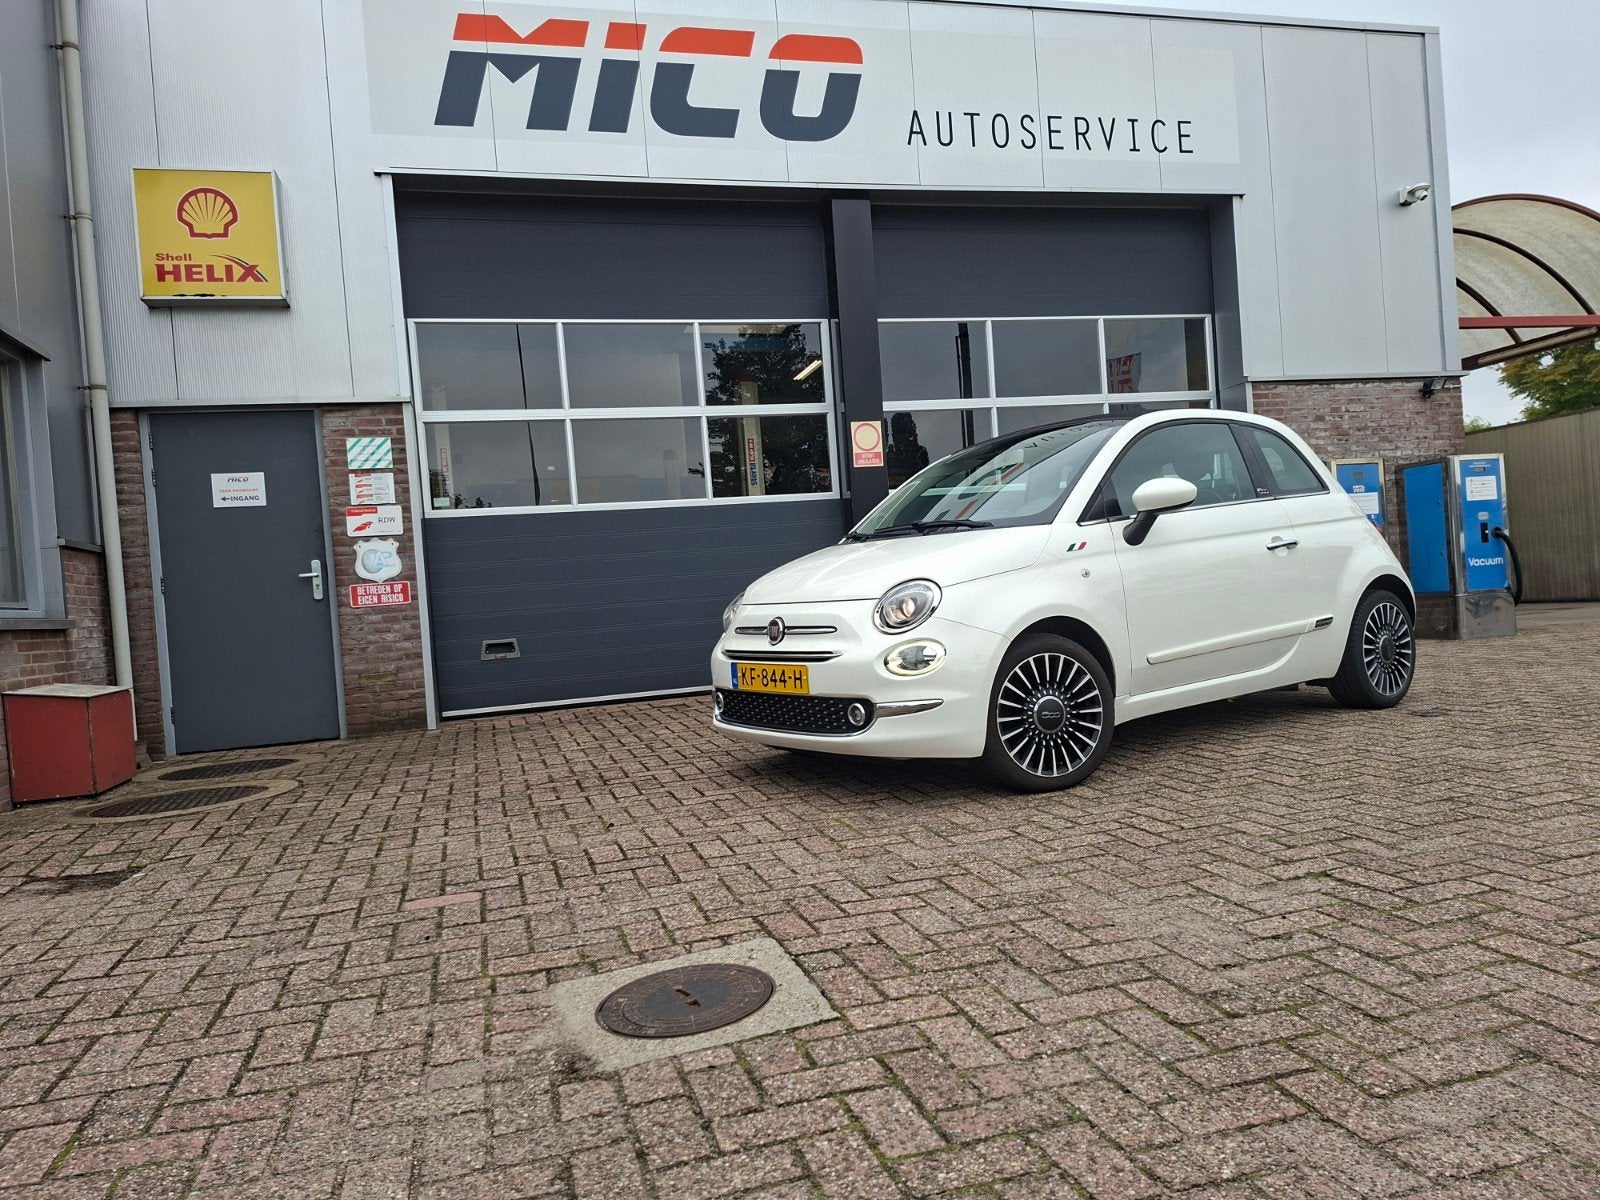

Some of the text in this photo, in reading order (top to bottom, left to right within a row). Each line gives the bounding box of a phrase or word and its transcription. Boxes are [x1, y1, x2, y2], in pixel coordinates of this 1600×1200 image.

[433, 12, 864, 143] MICO
[906, 109, 1194, 154] AUTOSERVICE
[155, 253, 192, 262] Shell
[154, 263, 265, 283] HELIX
[1468, 557, 1504, 567] Vacuum
[357, 584, 402, 596] BETREDEN OP
[358, 593, 404, 605] EIGEN RISICO
[741, 667, 803, 690] KF-844-H
